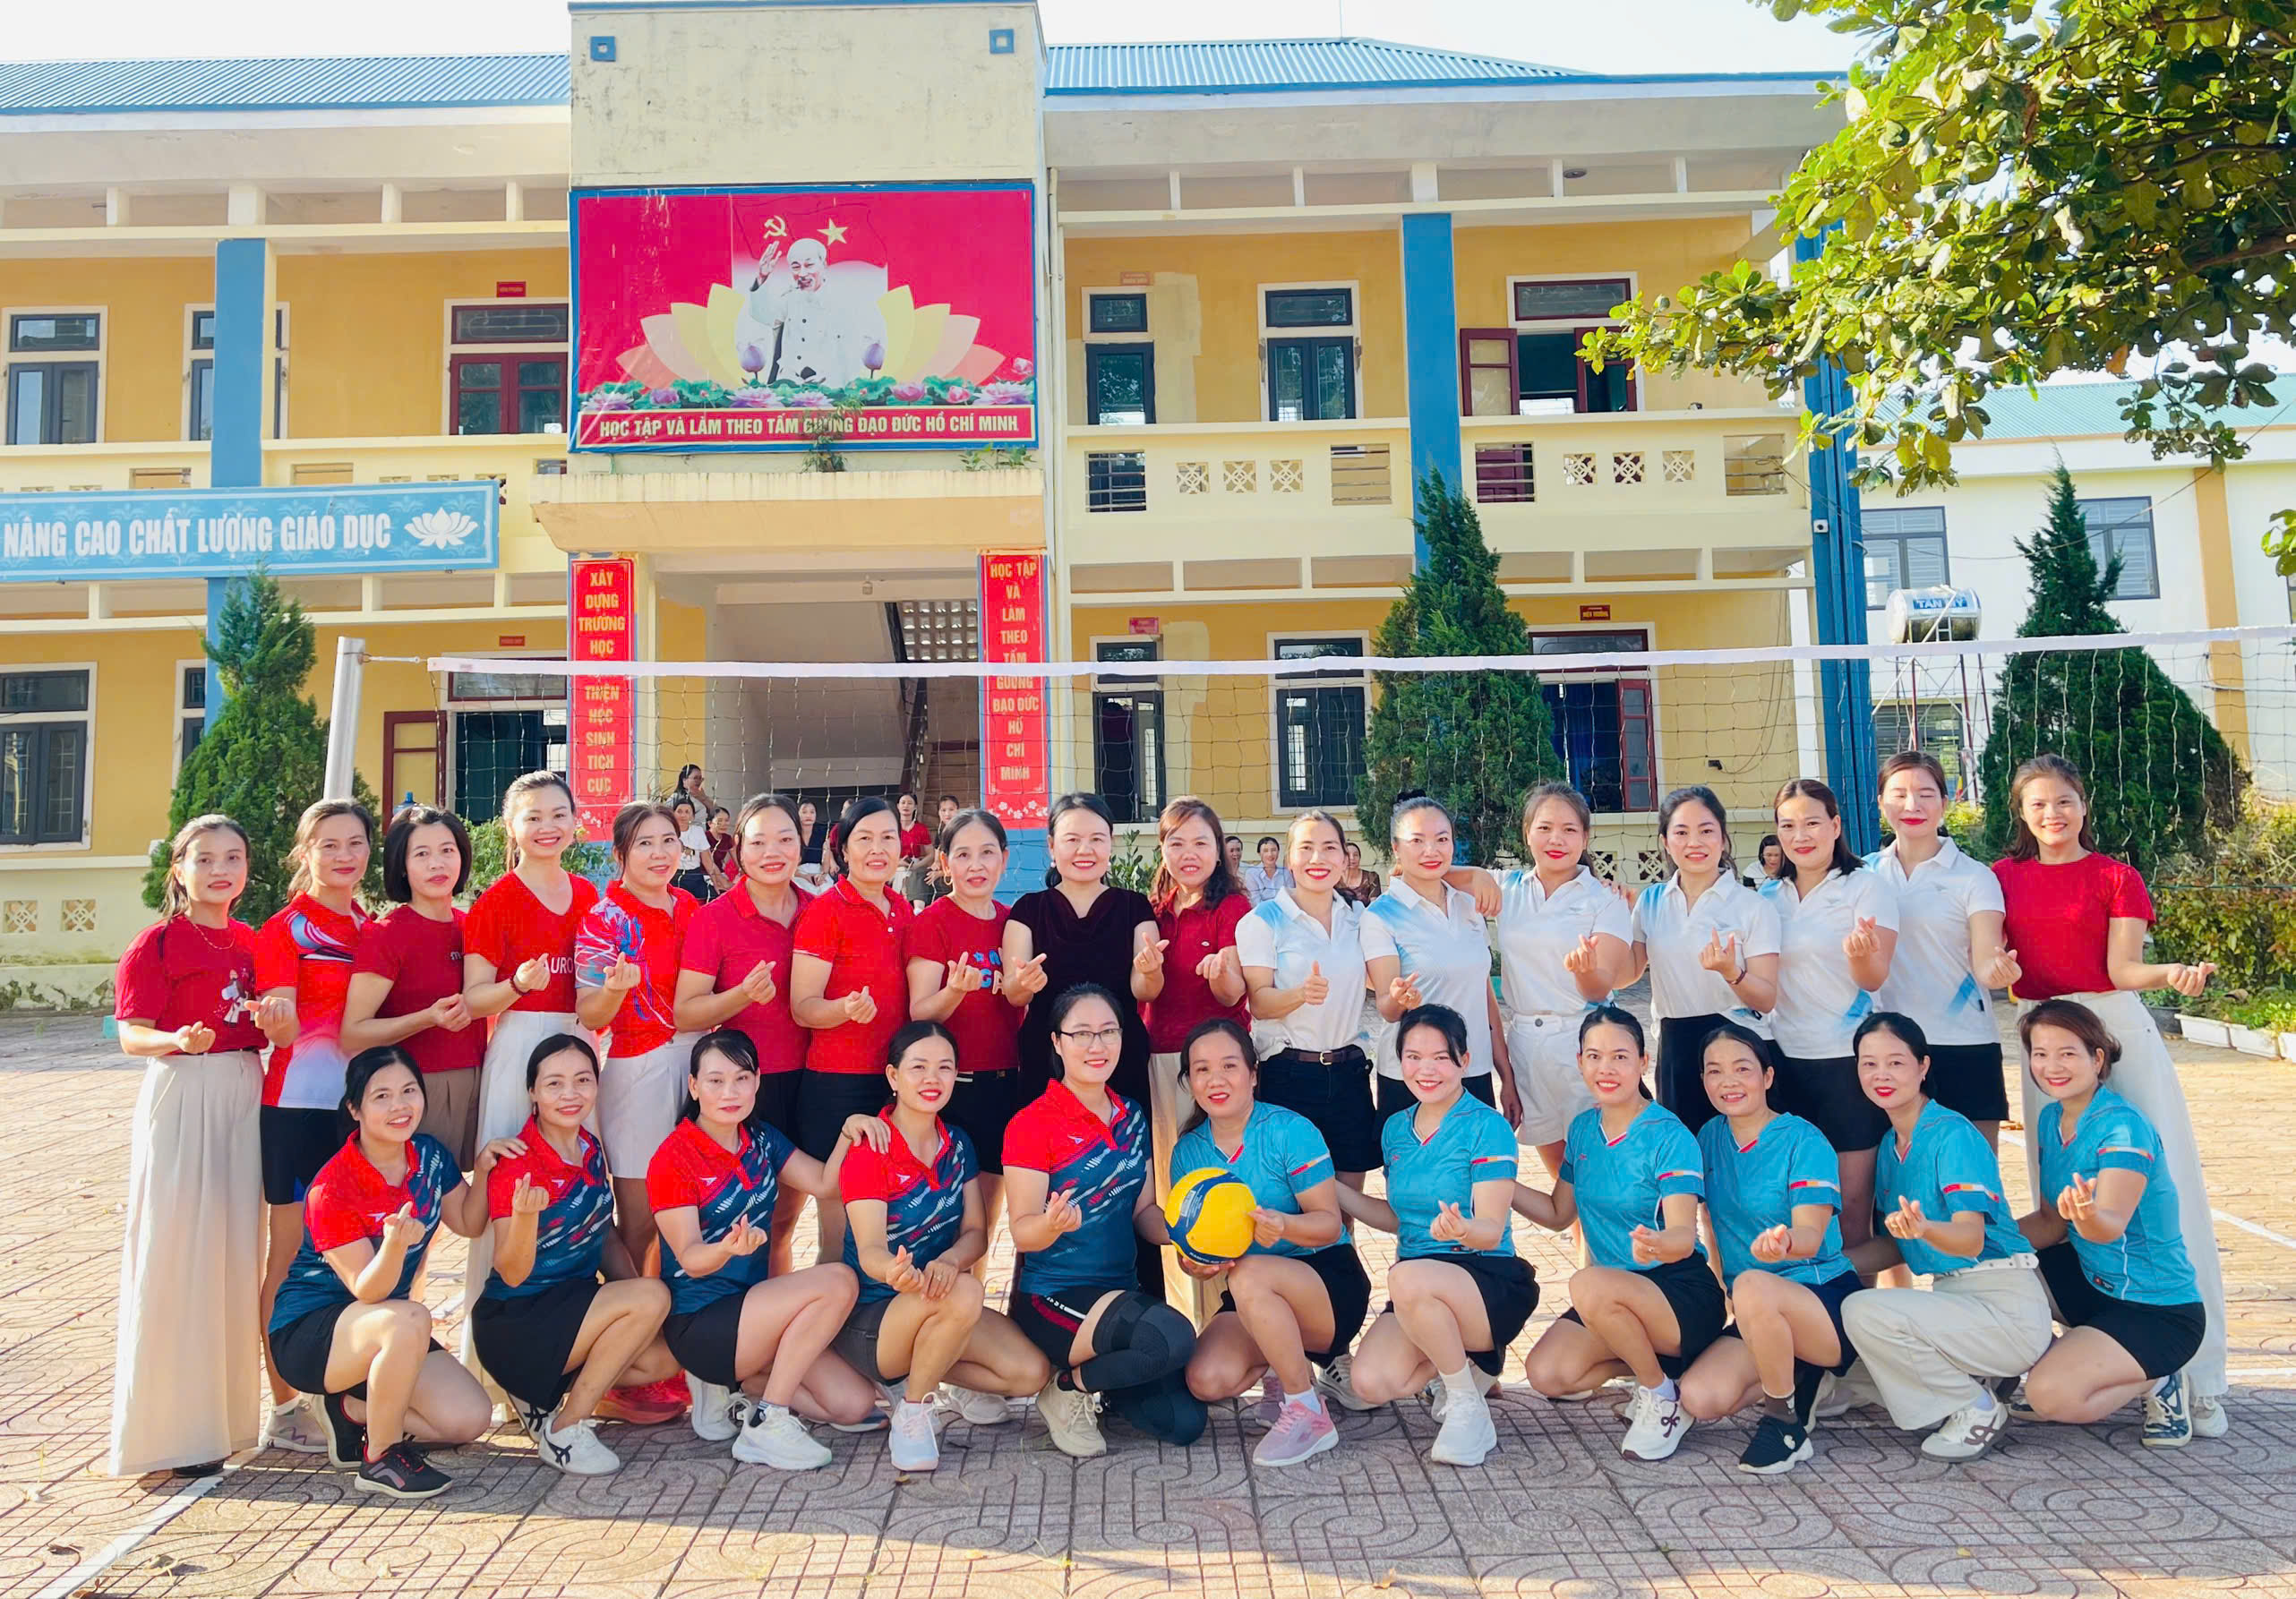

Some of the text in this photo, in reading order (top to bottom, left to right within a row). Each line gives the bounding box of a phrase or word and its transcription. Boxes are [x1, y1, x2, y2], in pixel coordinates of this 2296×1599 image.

[600, 419, 630, 440] HỌC
[634, 417, 662, 439] TẬP
[666, 416, 685, 434] VÀ
[690, 416, 722, 434] LÀM
[726, 418, 763, 434] THEO
[767, 413, 799, 433] TẤM
[858, 416, 887, 436] ĐẠO
[891, 413, 921, 432] ĐỨC
[925, 411, 946, 432] HỒ
[949, 413, 974, 432] CHÍ
[979, 415, 1019, 432] MINH
[4, 508, 390, 560] NÂNG CAO CHẤT LƯỢNG GIÁO DỤC
[590, 569, 614, 586] XÂY
[990, 560, 1037, 580] HỌC TẬP
[1006, 583, 1021, 599] VÀ
[585, 594, 620, 612] DỰNG
[578, 612, 626, 631] TRƯỜNG
[1002, 605, 1025, 621] LÀM
[1000, 630, 1028, 644] THEO
[590, 640, 614, 657] HỌC
[585, 684, 620, 703] THIỆN
[993, 695, 1040, 714] ĐẠO ĐỨC
[588, 708, 614, 725] HỌC
[586, 731, 615, 747] SINH
[1000, 766, 1030, 781] MINH
